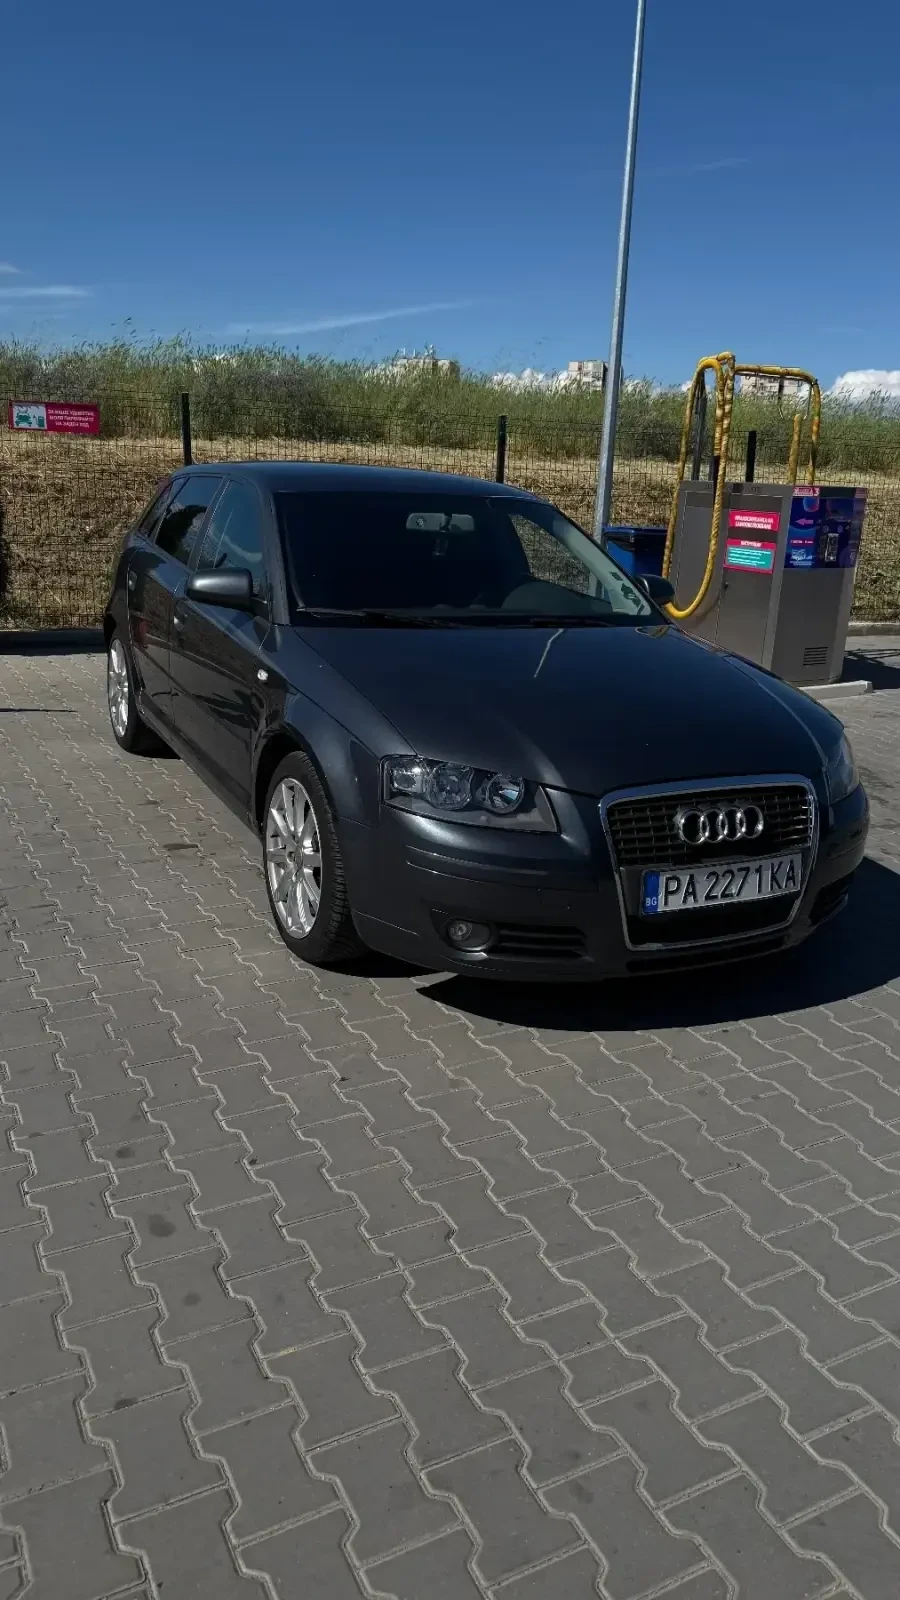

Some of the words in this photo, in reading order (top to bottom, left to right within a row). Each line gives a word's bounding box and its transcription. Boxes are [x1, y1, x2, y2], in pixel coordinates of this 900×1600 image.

[663, 874, 699, 906] PA
[704, 865, 763, 901] 2271
[769, 859, 796, 892] KA
[645, 897, 658, 907] BG
